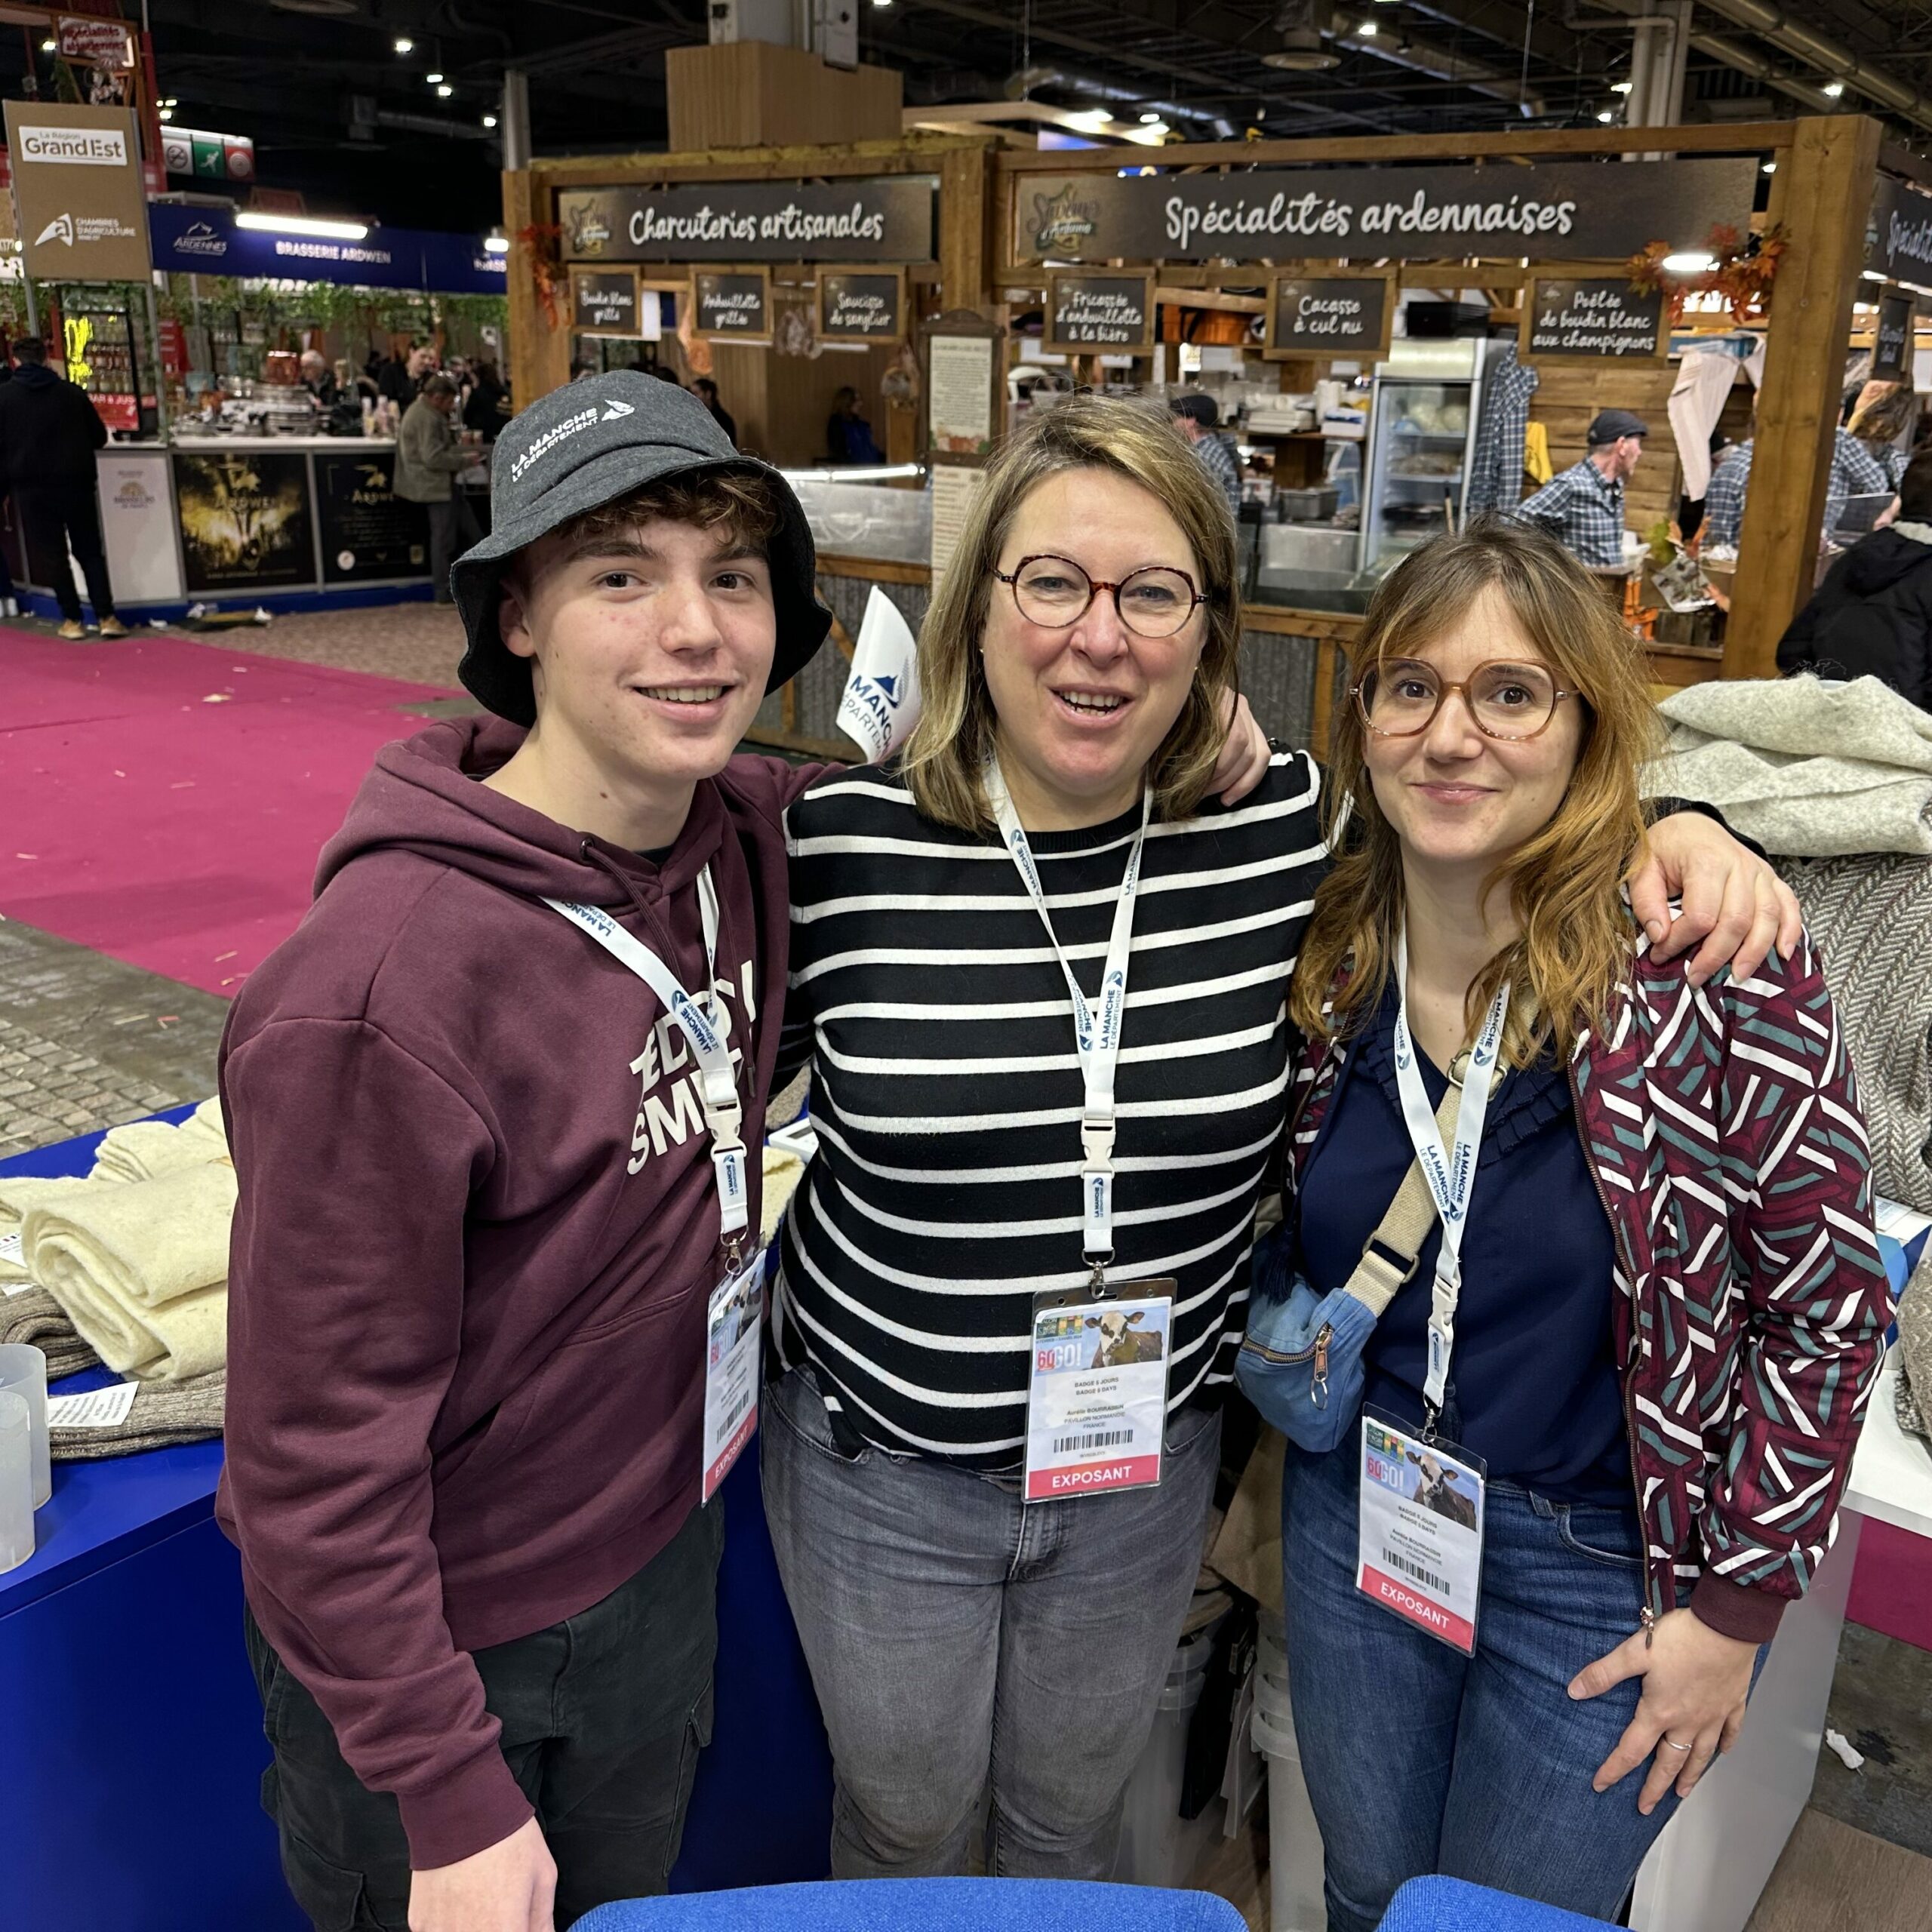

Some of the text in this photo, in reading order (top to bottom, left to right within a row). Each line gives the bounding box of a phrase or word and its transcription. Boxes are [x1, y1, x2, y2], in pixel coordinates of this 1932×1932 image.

[629, 205, 757, 245] Charcuteries
[760, 201, 884, 242] artisanales
[1165, 189, 1577, 251] Spécialités ardennaises
[275, 240, 391, 264] BRASSERIE ARDWEN
[703, 292, 761, 309] Andouillette
[837, 291, 885, 310] Saucisse
[1056, 303, 1143, 325] d'andouillette
[1072, 291, 1130, 309] Fricassée
[1298, 294, 1362, 316] Cacasse
[1573, 289, 1623, 311] Poêlée
[829, 307, 892, 333] de sanglier
[1068, 323, 1130, 343] à la bière
[1294, 315, 1364, 335] à cul nu
[1540, 310, 1652, 330] de boudin blanc
[1532, 328, 1656, 356] aux champignons
[511, 408, 598, 473] LA MANCHE
[512, 466, 524, 483] LE
[1017, 848, 1037, 890] MANCHE
[598, 921, 612, 937] LA
[681, 1009, 713, 1055] LA MANCHE
[687, 1004, 720, 1050] LE DÉPARTEMENT
[1100, 989, 1115, 1049] LA MANCHE
[1109, 989, 1122, 1049] LE DÉPARTEMENT
[1484, 1002, 1502, 1048] MANCHE
[1420, 1148, 1445, 1208] LE DÉPARTEMENT
[1426, 1145, 1450, 1206] LA MANCHE
[1451, 1141, 1463, 1201] LE DÉPARTEMENT
[1457, 1144, 1472, 1204] LA MANCHE
[1064, 1411, 1126, 1424] PAVILLON NORMANDIE
[715, 1424, 748, 1479] EXPOSANT
[1052, 1466, 1132, 1488] EXPOSANT
[1380, 1582, 1450, 1629] EXPOSANT
